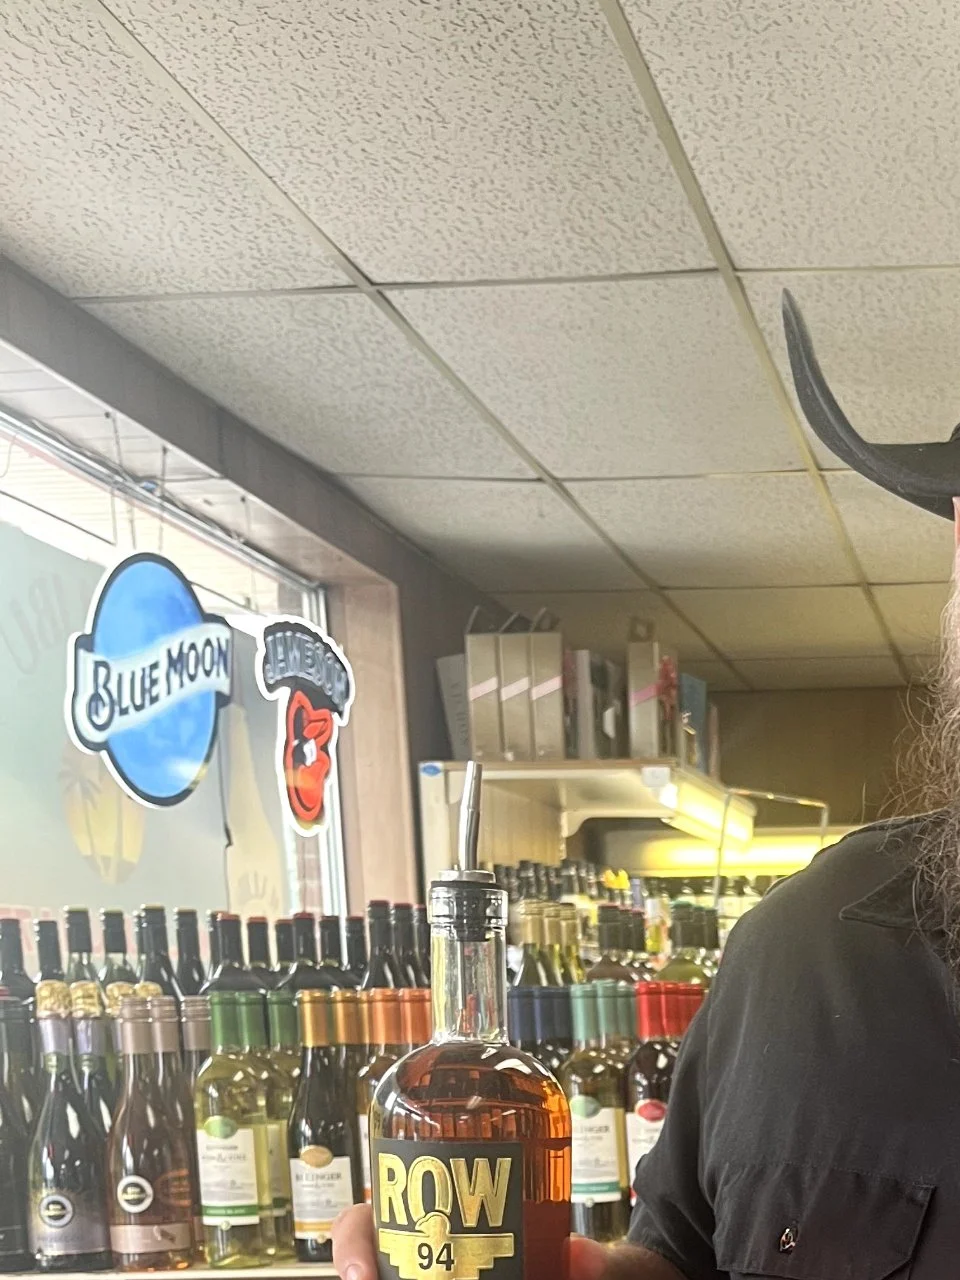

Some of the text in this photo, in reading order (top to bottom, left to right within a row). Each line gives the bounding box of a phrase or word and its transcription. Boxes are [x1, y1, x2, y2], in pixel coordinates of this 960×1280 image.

[86, 634, 229, 732] BLUE MOON
[379, 1152, 513, 1228] ROW
[417, 1242, 455, 1272] 94
